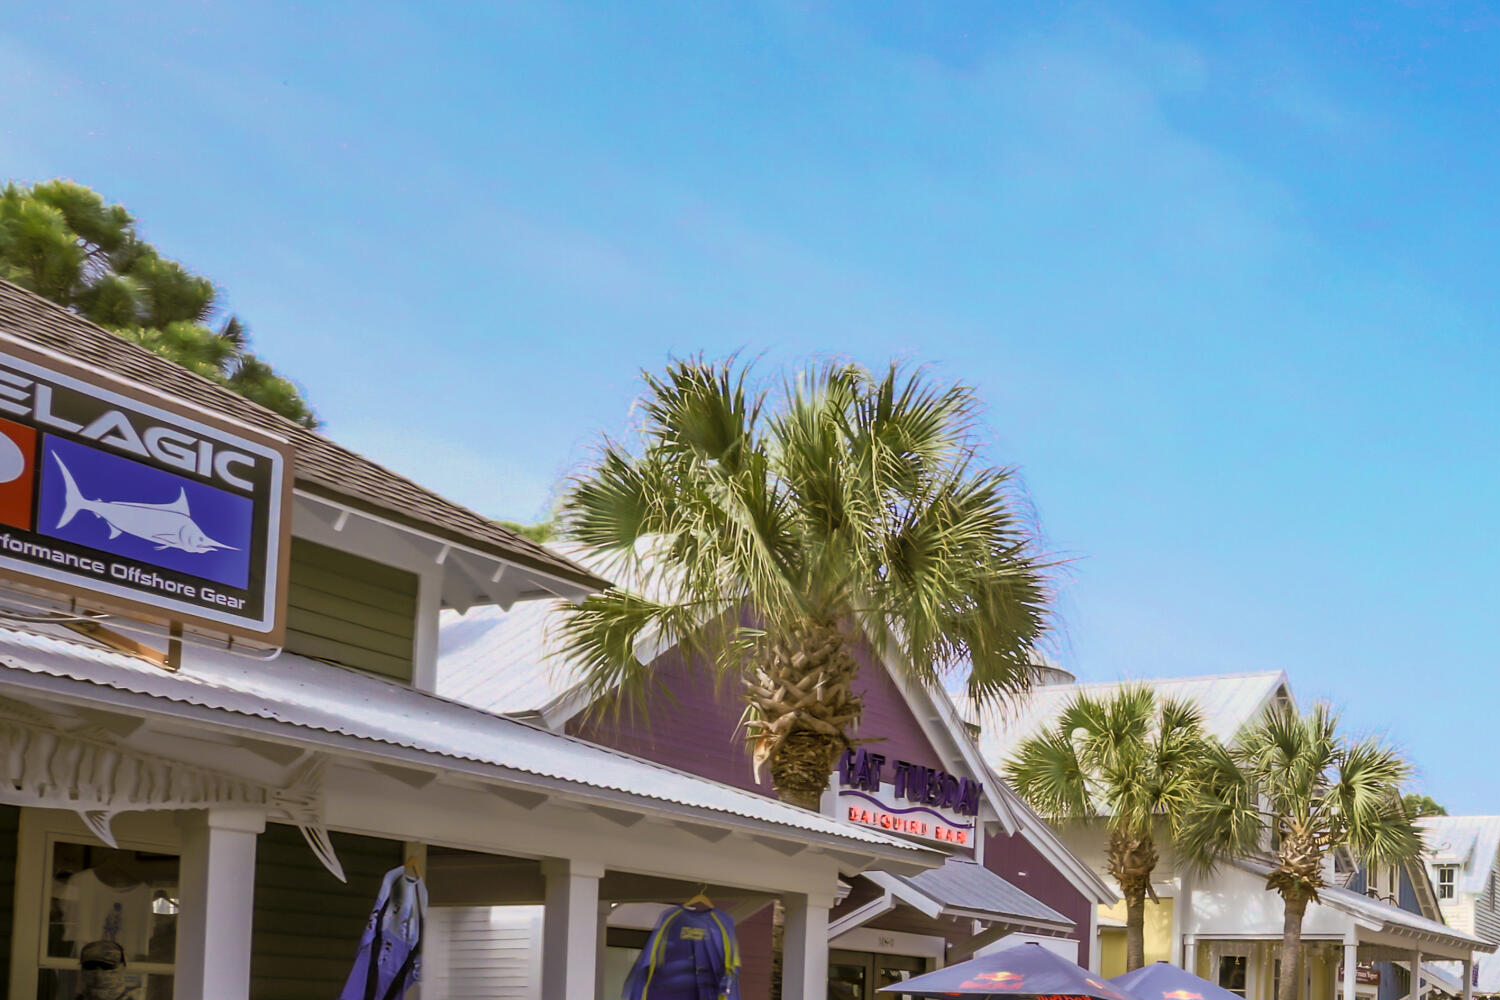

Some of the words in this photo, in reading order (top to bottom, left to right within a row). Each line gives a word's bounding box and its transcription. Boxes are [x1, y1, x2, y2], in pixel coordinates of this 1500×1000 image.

[111, 564, 196, 597] Offshore
[201, 587, 245, 610] Gear
[840, 747, 886, 792] FAT
[893, 760, 983, 816] TUESDAY
[848, 806, 928, 835] DAIQUIRI
[935, 826, 968, 844] BAR
